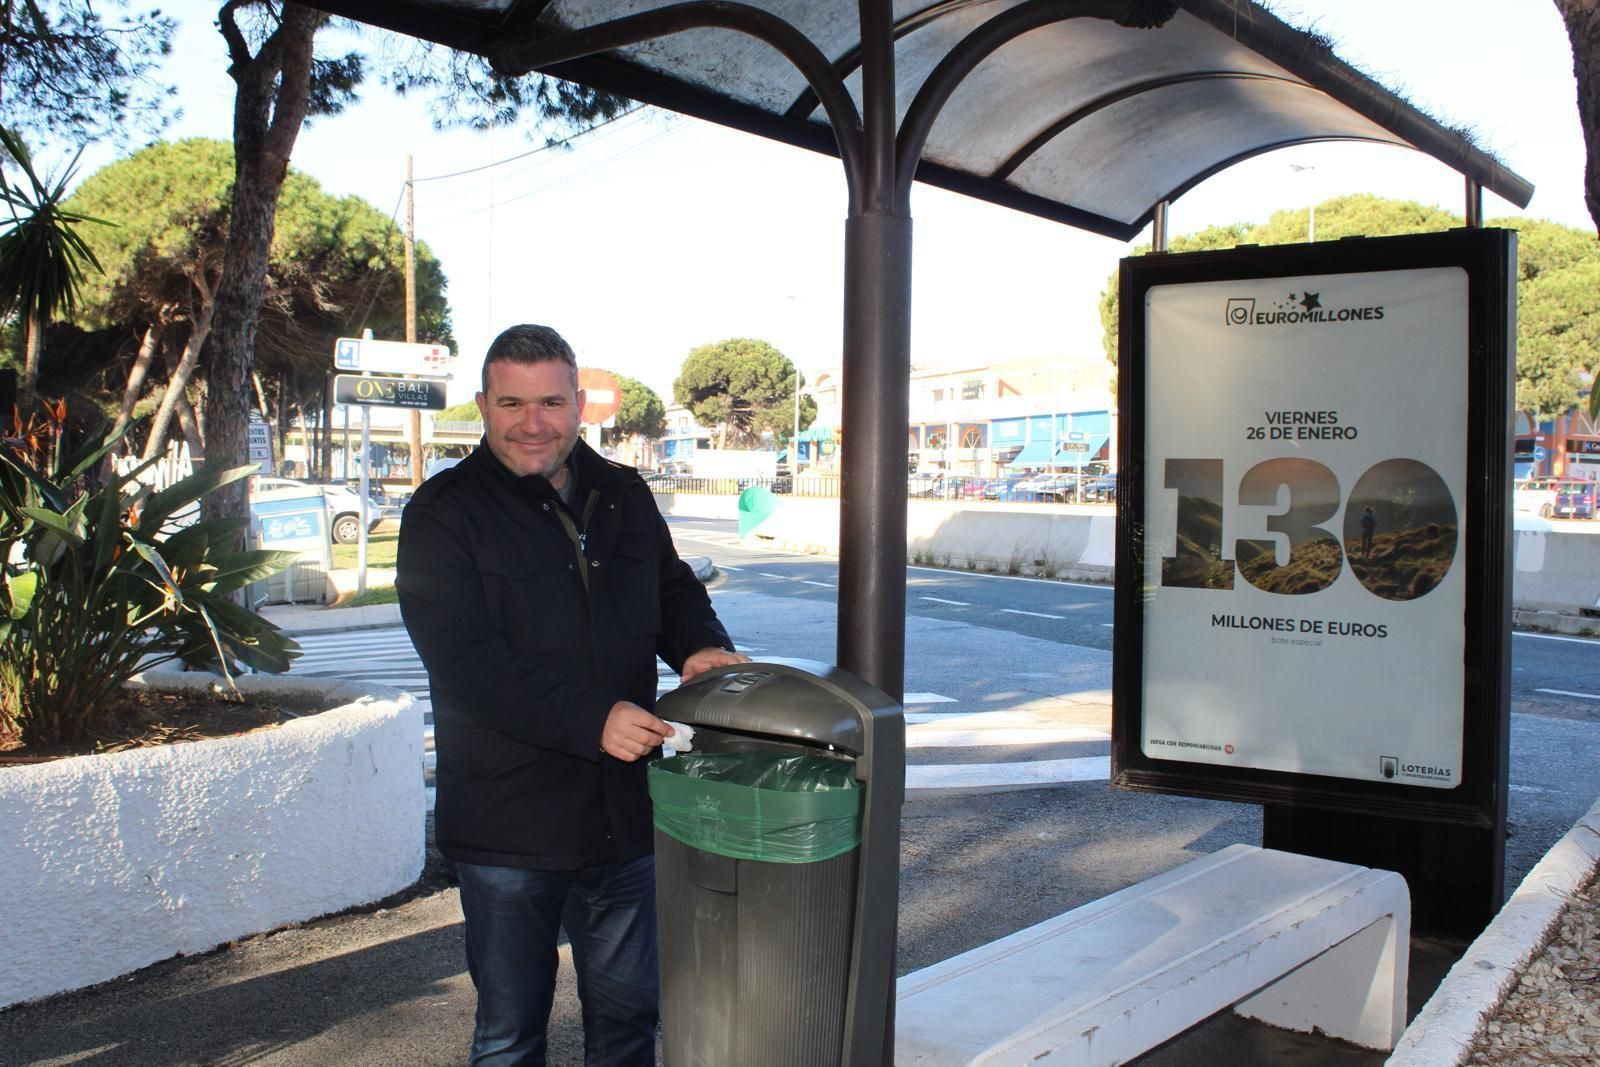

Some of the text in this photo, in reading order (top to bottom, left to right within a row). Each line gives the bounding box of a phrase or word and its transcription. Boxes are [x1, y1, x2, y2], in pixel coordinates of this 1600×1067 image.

[1255, 306, 1385, 325] EUROMILLONES
[356, 379, 430, 399] ONE BALI
[398, 393, 429, 402] VILLAS
[1264, 410, 1339, 425] VIERNES
[1245, 426, 1358, 441] 26 DE ENERO
[1161, 457, 1459, 602] 130
[1211, 613, 1388, 639] MILLONES DE EUROS
[1271, 636, 1323, 648] bote especial
[1401, 764, 1452, 777] LOTERÍAS
